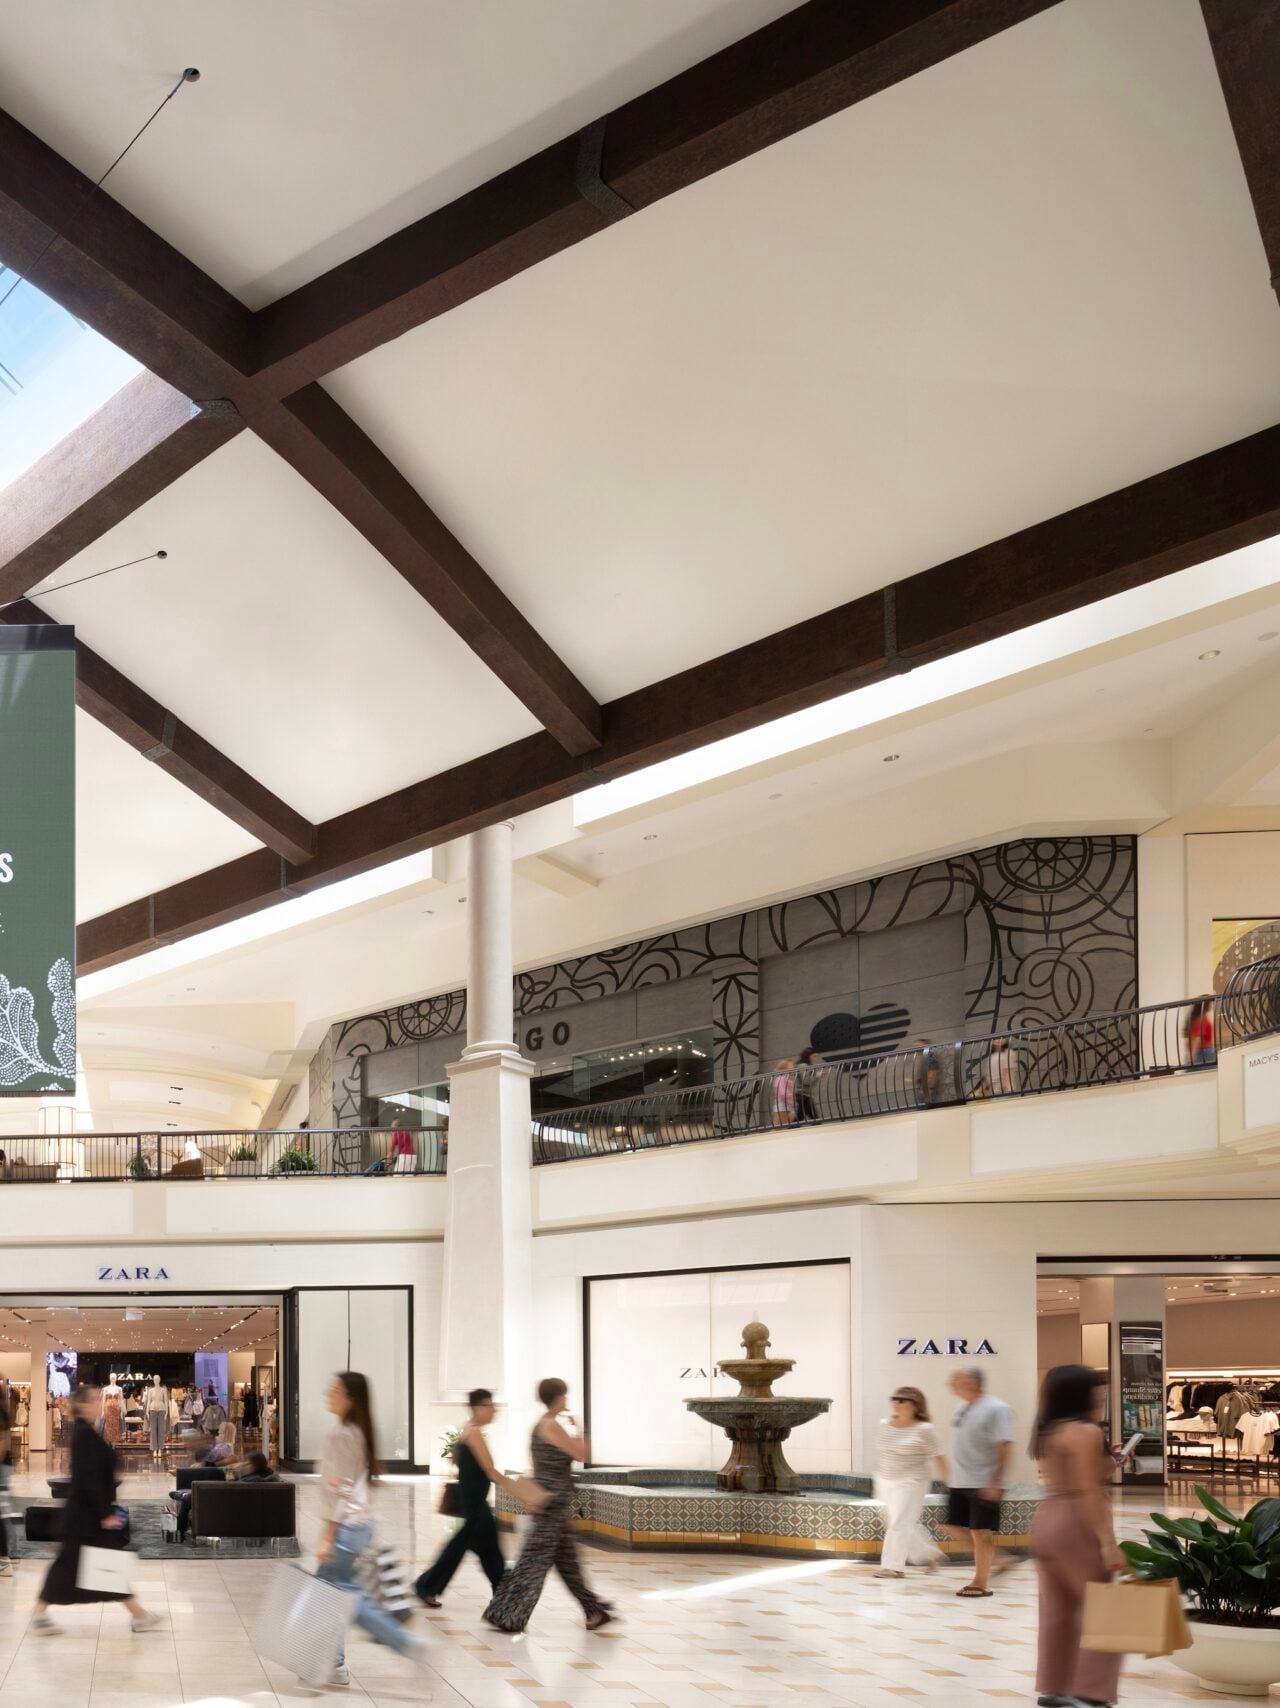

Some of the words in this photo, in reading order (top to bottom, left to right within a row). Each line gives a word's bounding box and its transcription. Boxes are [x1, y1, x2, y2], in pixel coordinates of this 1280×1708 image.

[513, 1021, 570, 1052] GO
[1249, 1053, 1280, 1068] MACY'S
[98, 1267, 170, 1280] ZARA
[897, 1338, 999, 1355] ZARA
[117, 1372, 153, 1381] ZARA
